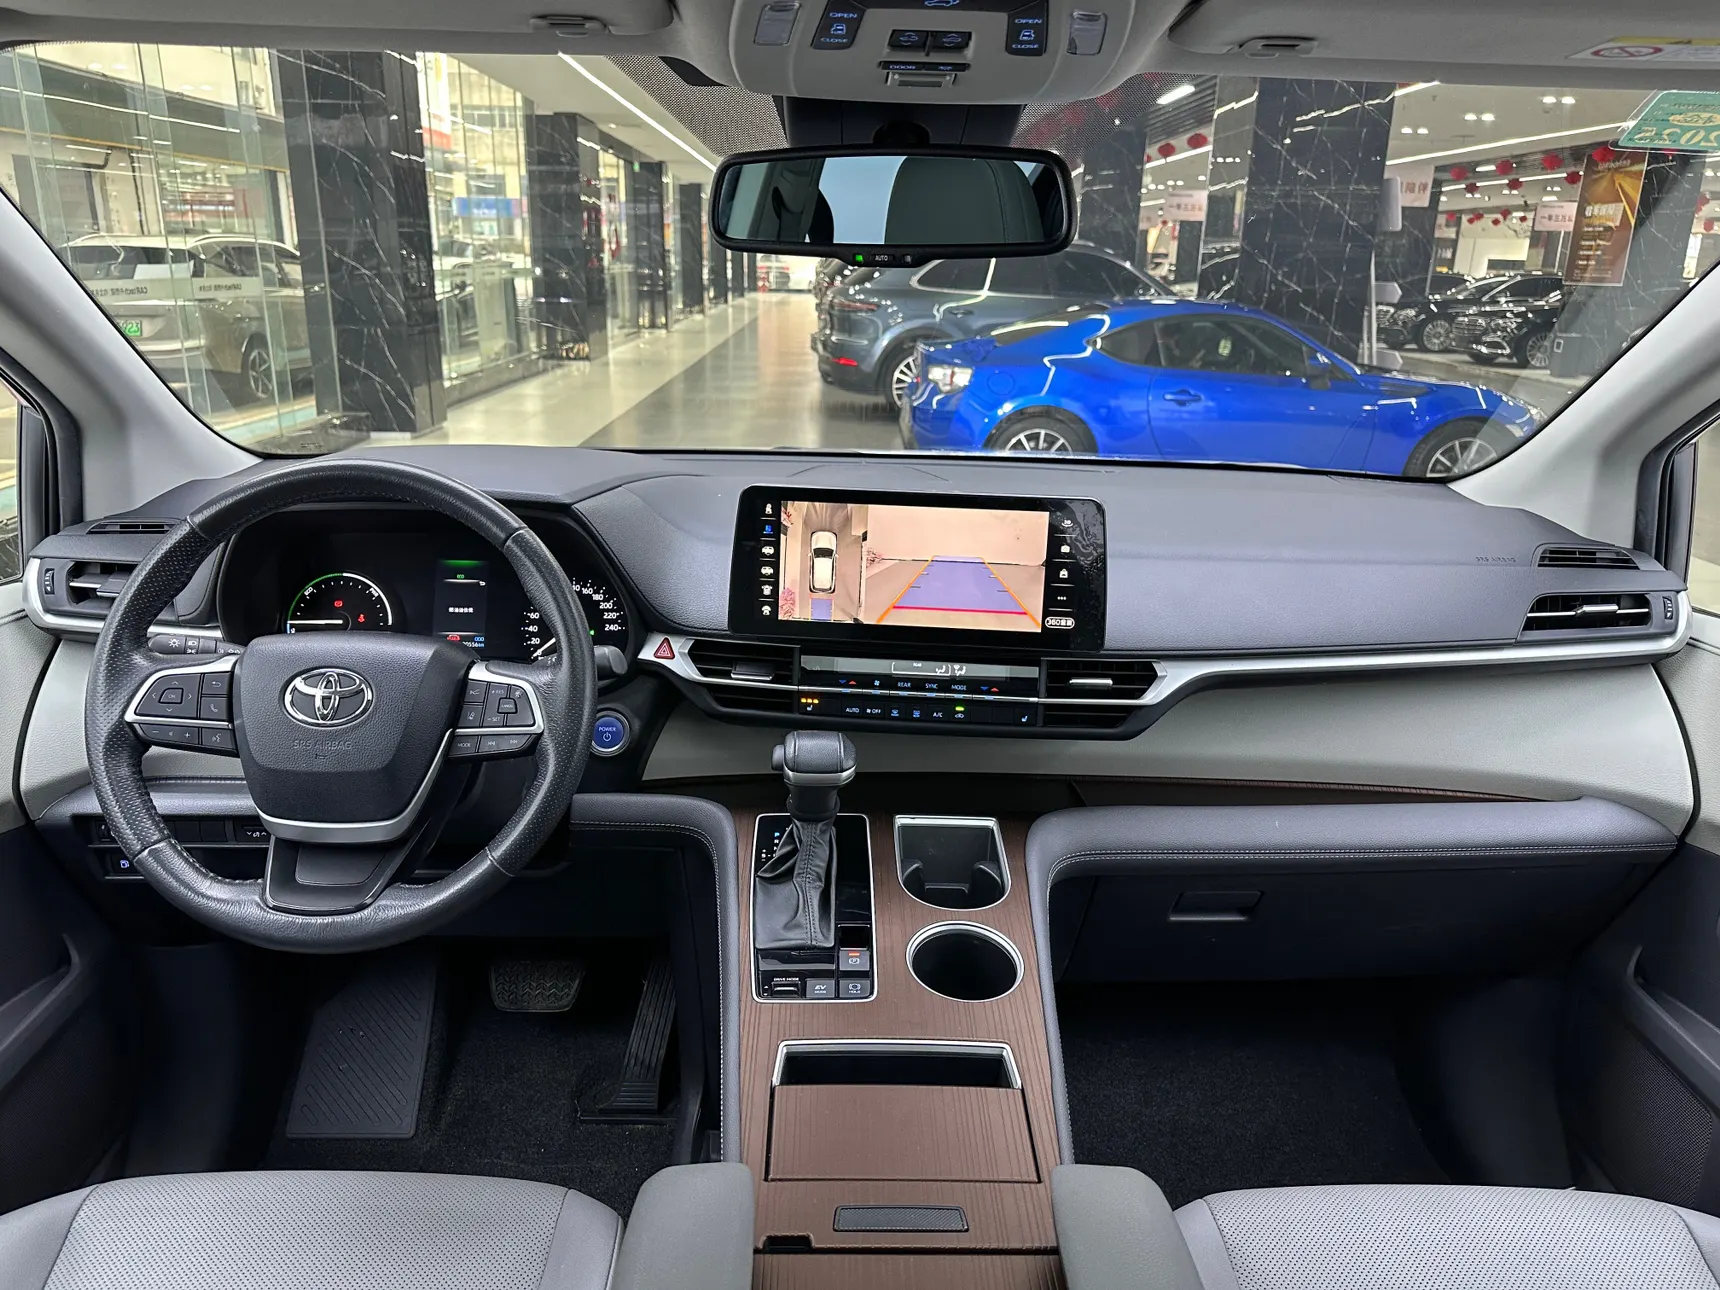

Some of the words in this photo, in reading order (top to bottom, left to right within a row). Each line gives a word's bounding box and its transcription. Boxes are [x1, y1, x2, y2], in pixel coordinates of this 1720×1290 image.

[581, 587, 593, 595] 160
[592, 593, 604, 601] 180
[603, 611, 617, 619] 220
[604, 624, 618, 632] 240
[293, 740, 312, 749] SRS
[314, 740, 352, 750] AIRBAG
